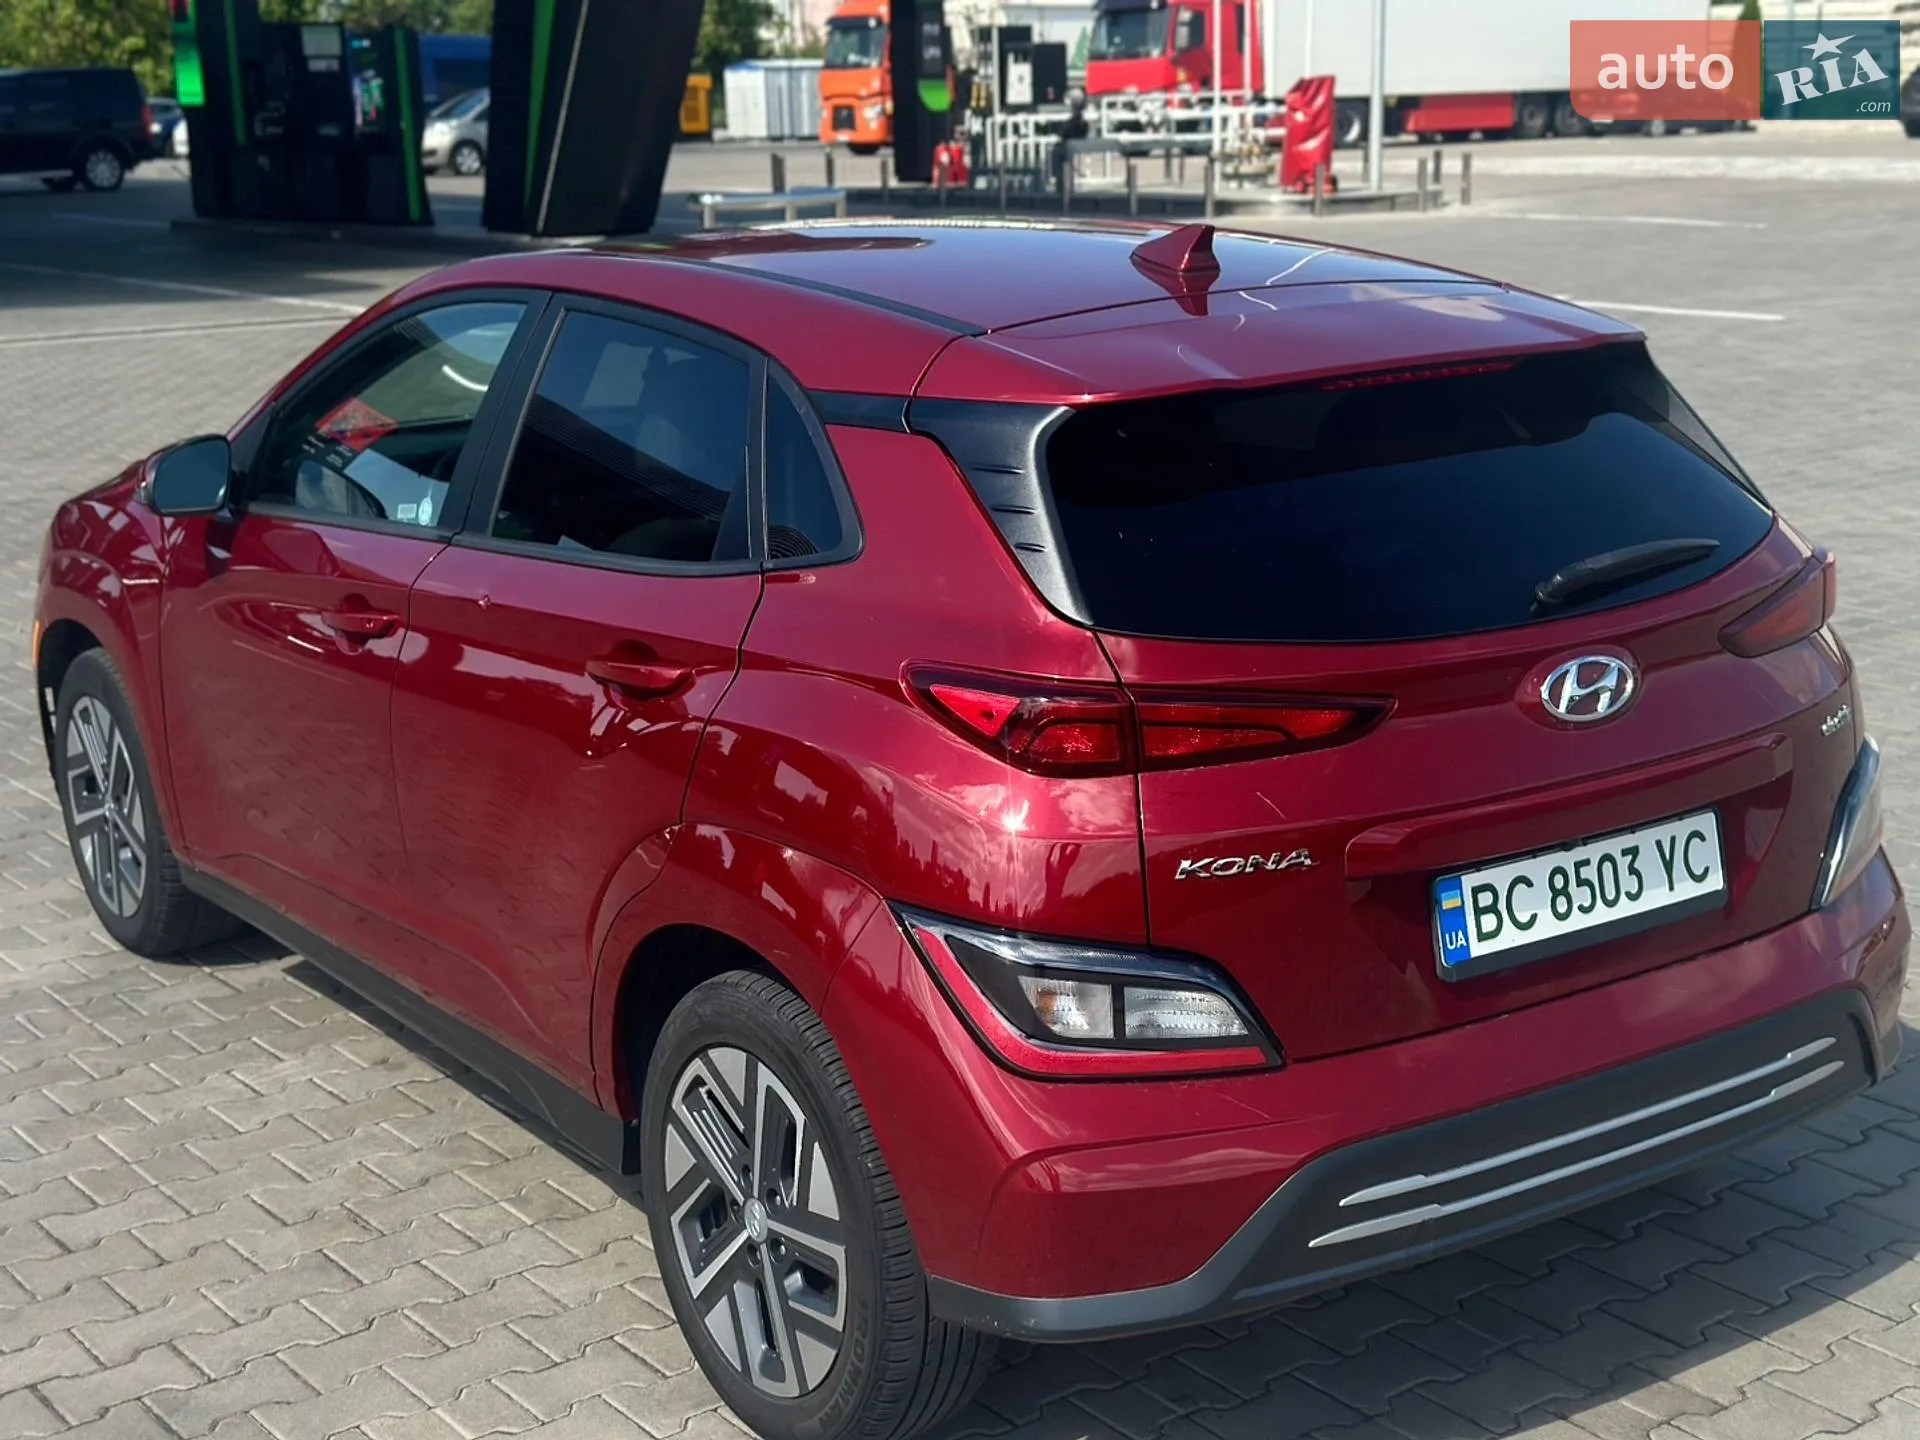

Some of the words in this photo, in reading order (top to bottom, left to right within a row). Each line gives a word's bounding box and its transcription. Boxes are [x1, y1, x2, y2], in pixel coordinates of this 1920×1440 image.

[1174, 848, 1313, 880] KONA
[1470, 874, 1538, 943] BC
[1548, 844, 1644, 922] 8503
[1655, 829, 1711, 893] YC
[1445, 929, 1467, 950] UA
